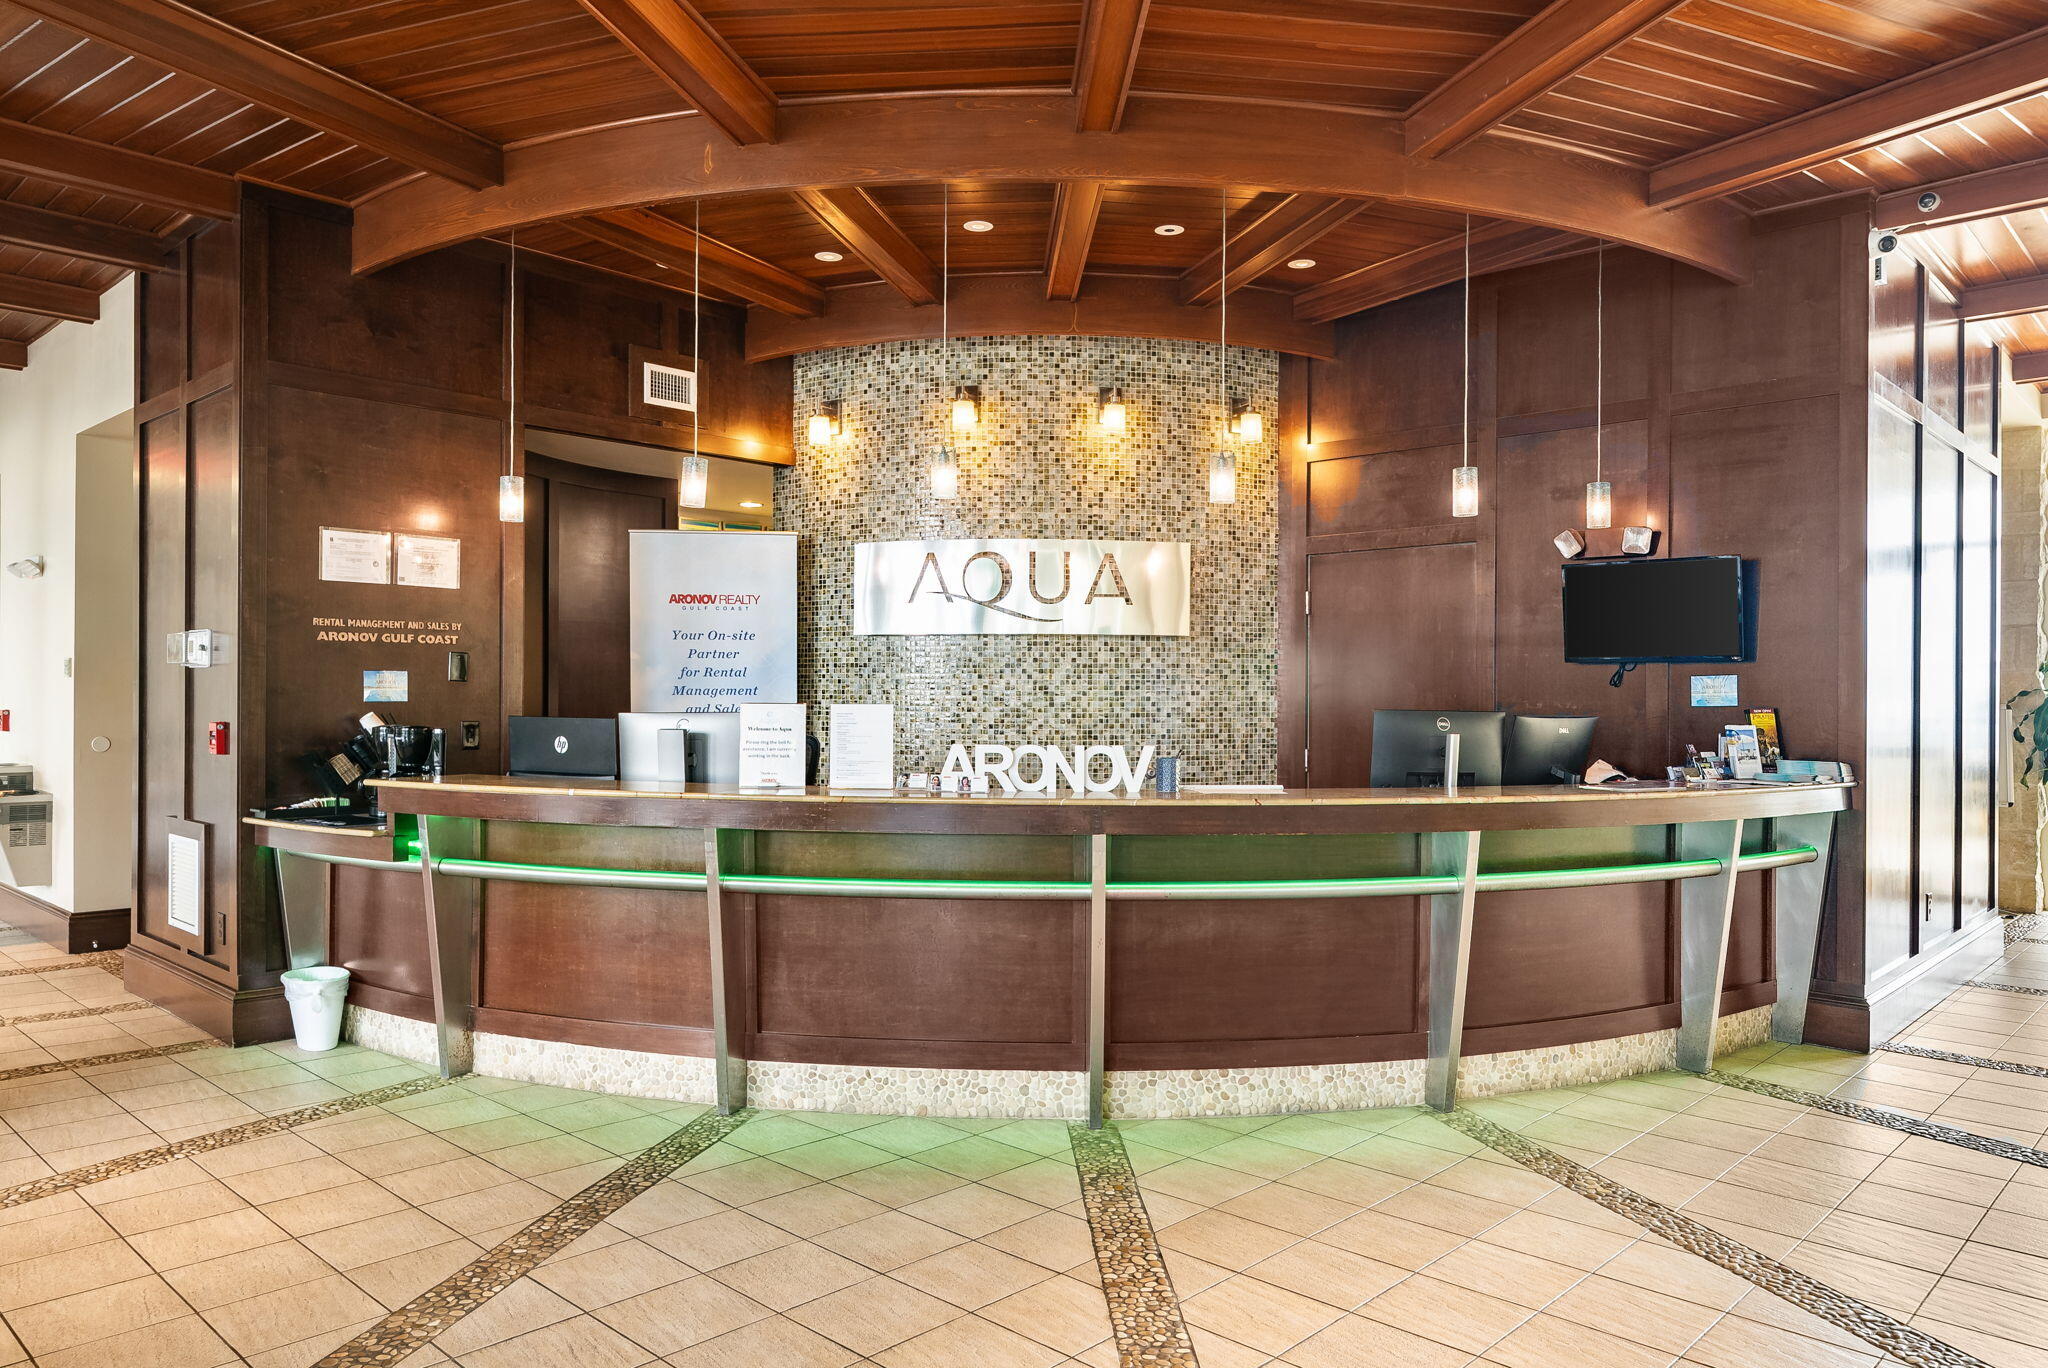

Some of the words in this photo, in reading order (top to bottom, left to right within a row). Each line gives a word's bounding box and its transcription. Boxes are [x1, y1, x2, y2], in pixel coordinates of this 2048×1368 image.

[908, 551, 1133, 622] AQUA
[669, 594, 718, 604] ARONOV
[719, 594, 760, 604] REALTY
[313, 617, 345, 627] RENTAL
[348, 619, 405, 629] MANAGEMENT
[408, 621, 424, 630] AND
[427, 622, 449, 631] SALES
[452, 622, 462, 631] BY
[317, 631, 378, 643] ARONOV
[381, 633, 414, 643] GULF
[418, 635, 459, 645] COAST
[672, 630, 704, 641] Your
[708, 630, 756, 641] On-site
[687, 649, 740, 659] Partner
[678, 667, 700, 680] for
[703, 667, 747, 678] Rental
[672, 685, 759, 698] Management
[685, 704, 711, 713] and
[714, 704, 741, 713] Sale
[556, 736, 567, 753] hp
[940, 744, 1156, 793] ARONOV
